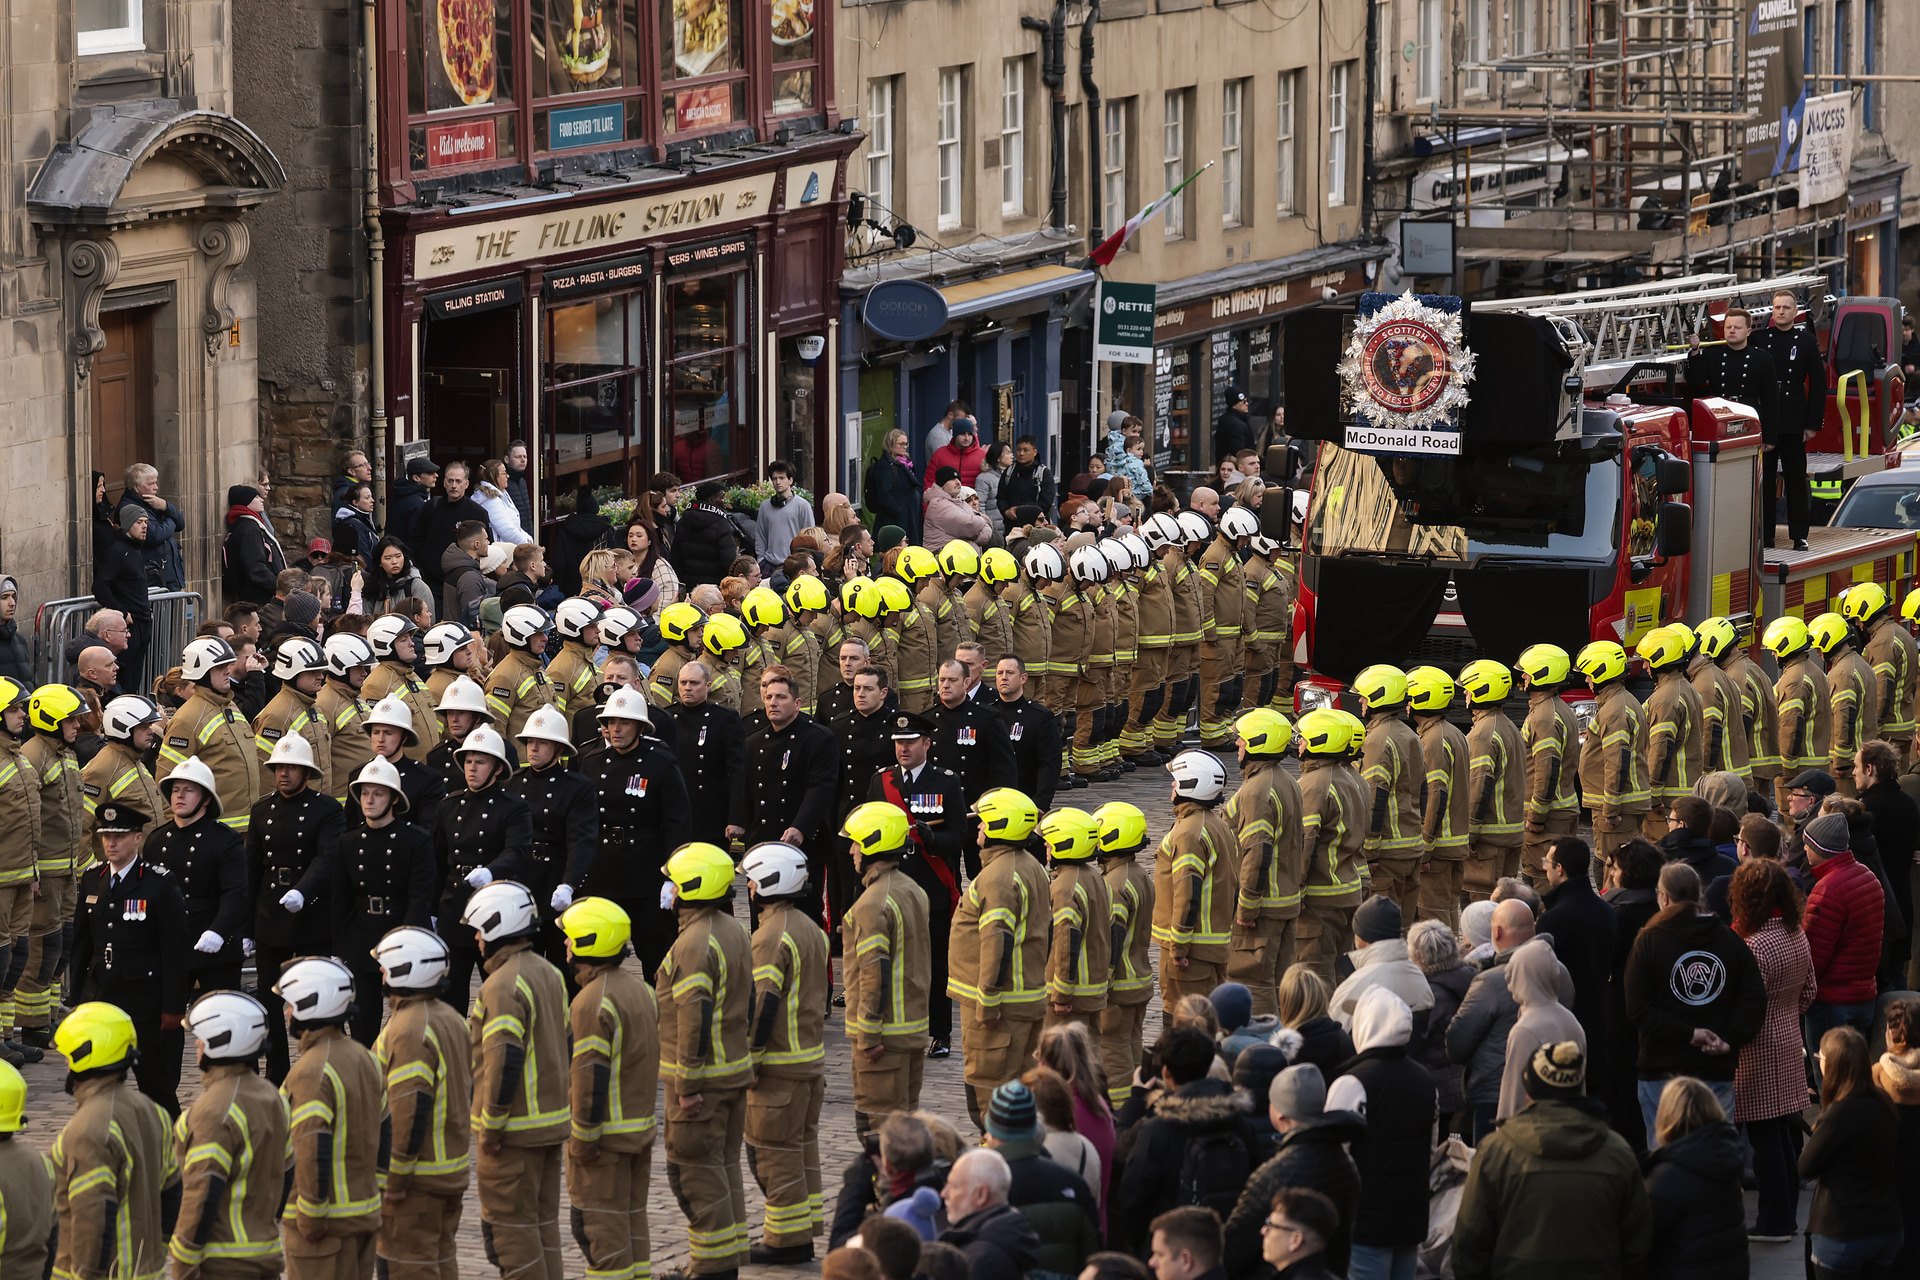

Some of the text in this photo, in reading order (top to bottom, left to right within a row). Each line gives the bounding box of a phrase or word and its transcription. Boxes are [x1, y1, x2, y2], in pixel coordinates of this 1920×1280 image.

[559, 122, 572, 137] FOOD
[572, 120, 592, 135] SERVED
[602, 116, 614, 132] LATE
[439, 132, 486, 156] Kids welcome
[475, 229, 520, 262] THE
[538, 211, 625, 250] FILLING
[642, 192, 724, 232] STATION
[694, 247, 718, 261] WINES
[720, 241, 745, 255] SPIRITS
[552, 263, 642, 289] PIZZA PASTA BURGERS
[445, 289, 505, 312] FILLING STATION
[1118, 301, 1153, 313] RETTIE
[1211, 280, 1288, 319] The Whisky Trail
[1167, 307, 1186, 326] Whisky
[1381, 326, 1428, 342] SCOTTISH
[1212, 354, 1229, 370] WHISKY
[1250, 347, 1274, 370] pecialist
[1364, 356, 1443, 406] FIRE AND RESCUE SERVICE
[1346, 431, 1459, 449] McDonald Road
